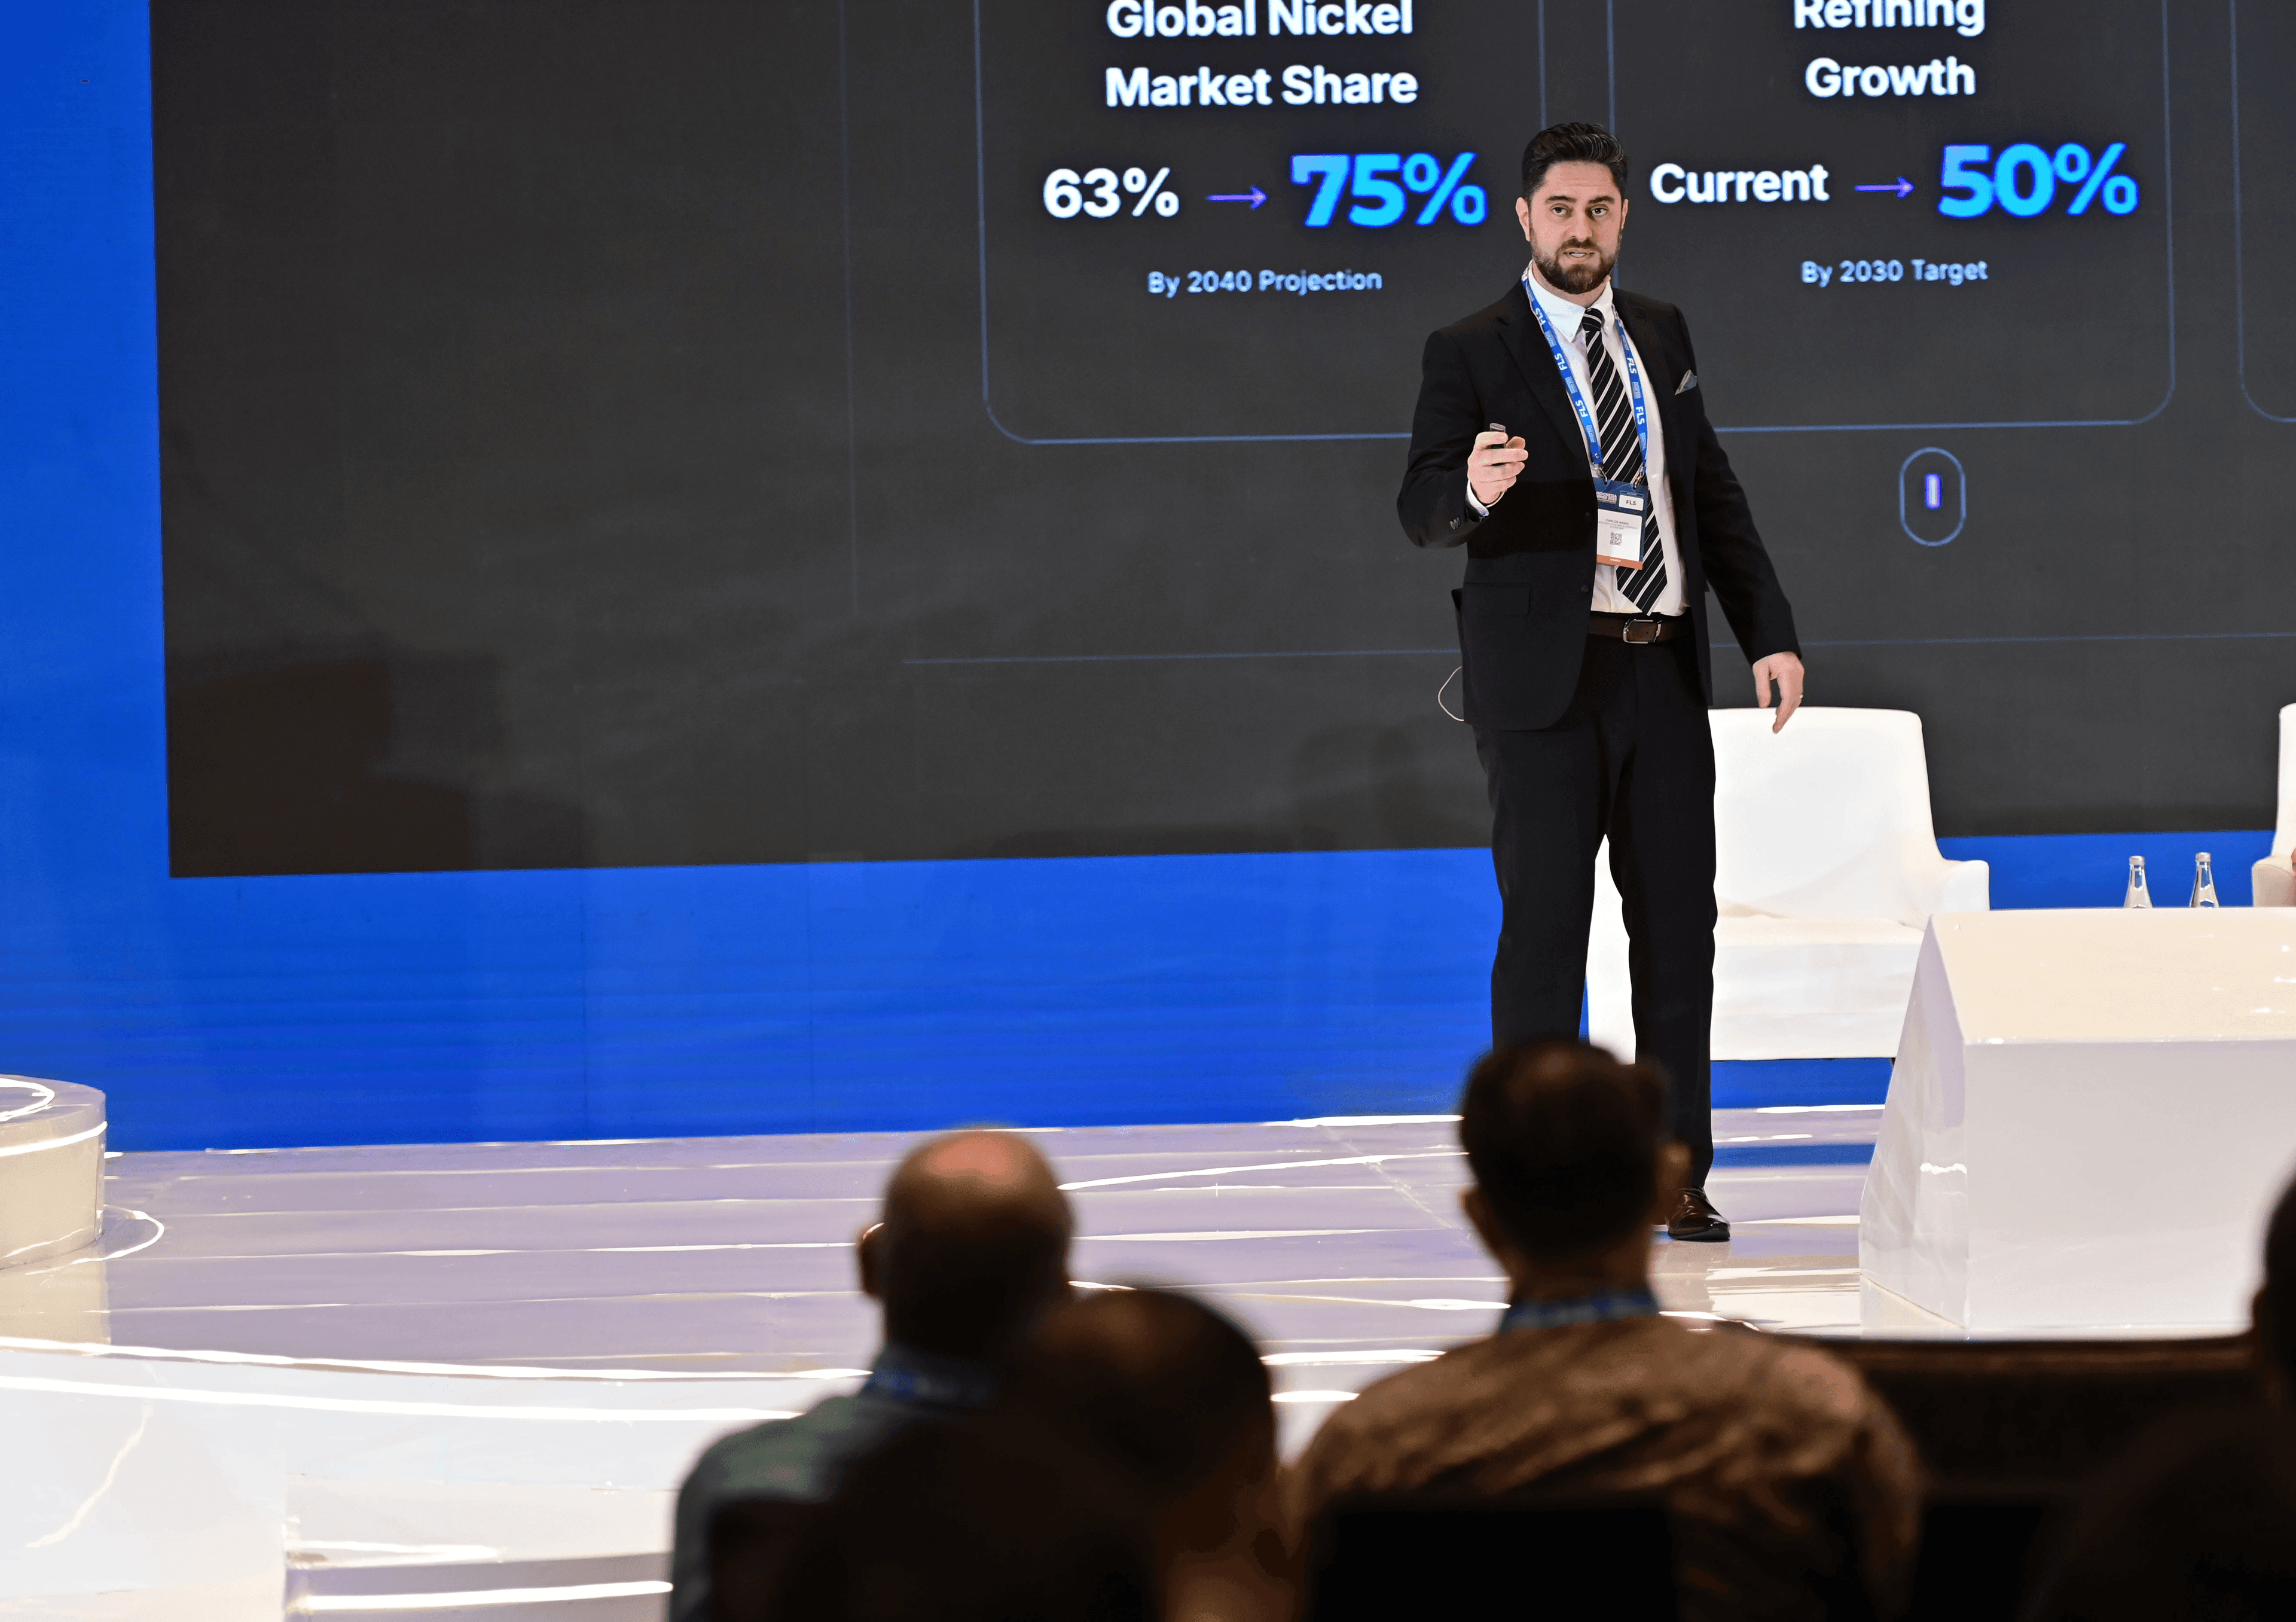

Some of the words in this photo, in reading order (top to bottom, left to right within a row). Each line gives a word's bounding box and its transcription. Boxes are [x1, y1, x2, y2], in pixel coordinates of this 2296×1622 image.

[1107, 0, 1256, 38] Global
[1268, 0, 1412, 35] Nickel
[1794, 0, 1984, 36] Refining
[1106, 66, 1272, 107] Market
[1282, 65, 1418, 105] Share
[1806, 56, 1975, 97] Growth
[1043, 167, 1179, 218] 63%
[1291, 152, 1488, 227] 75%
[1650, 163, 1829, 203] Current
[1938, 142, 2139, 218] 50%
[1149, 272, 1180, 298] By
[1188, 270, 1252, 292] 2040
[1259, 270, 1382, 295] Projection
[1802, 261, 1832, 287] By
[1840, 260, 1903, 282] 2030
[1912, 260, 1987, 286] Target
[1554, 353, 1568, 371] FLS
[1626, 357, 1637, 374] FLS
[1575, 400, 1589, 417] FLS
[1635, 406, 1645, 425] FLS
